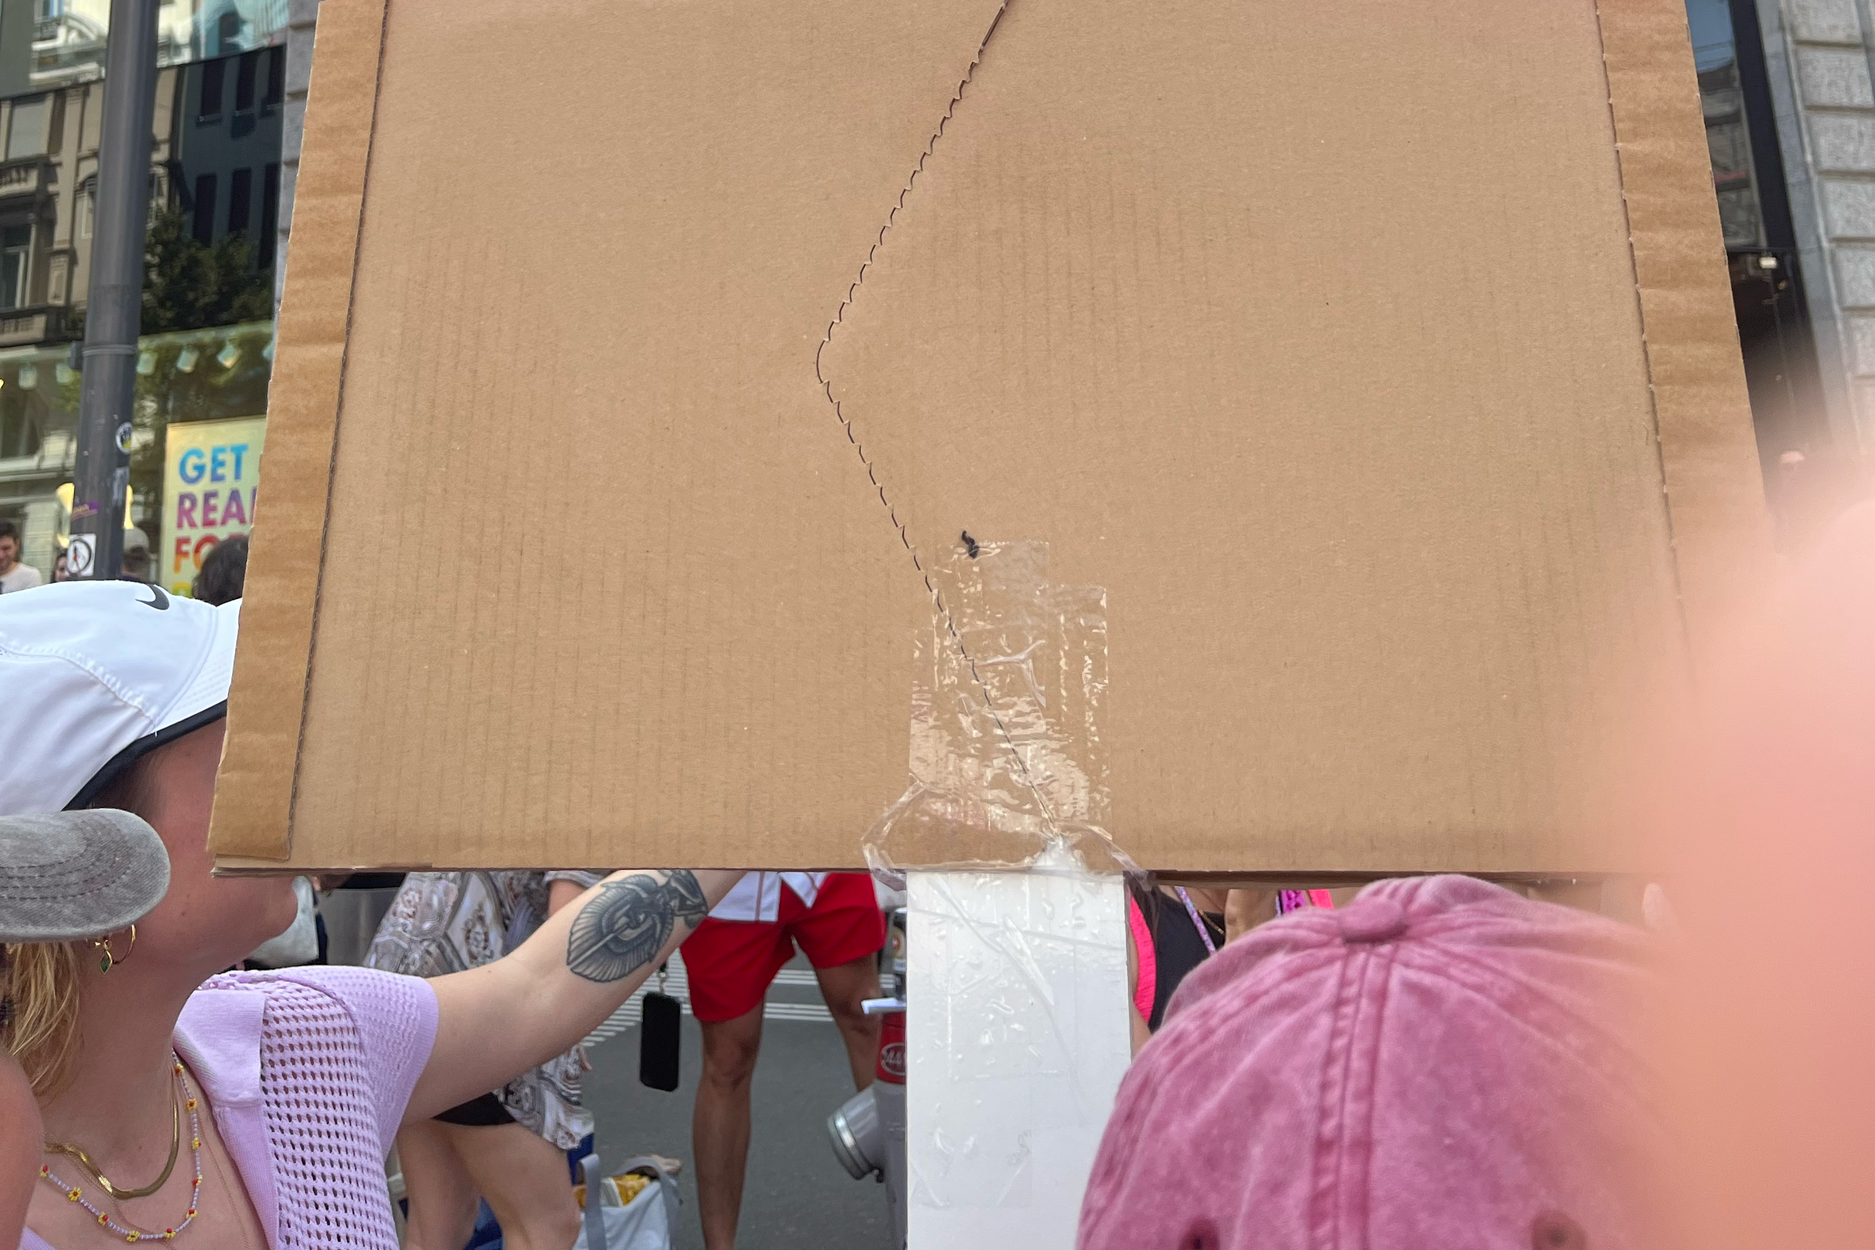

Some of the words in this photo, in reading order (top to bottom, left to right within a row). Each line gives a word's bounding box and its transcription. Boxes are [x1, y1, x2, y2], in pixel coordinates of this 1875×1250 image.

[179, 444, 249, 484] GET
[177, 486, 258, 529] REA
[174, 534, 244, 574] FO
